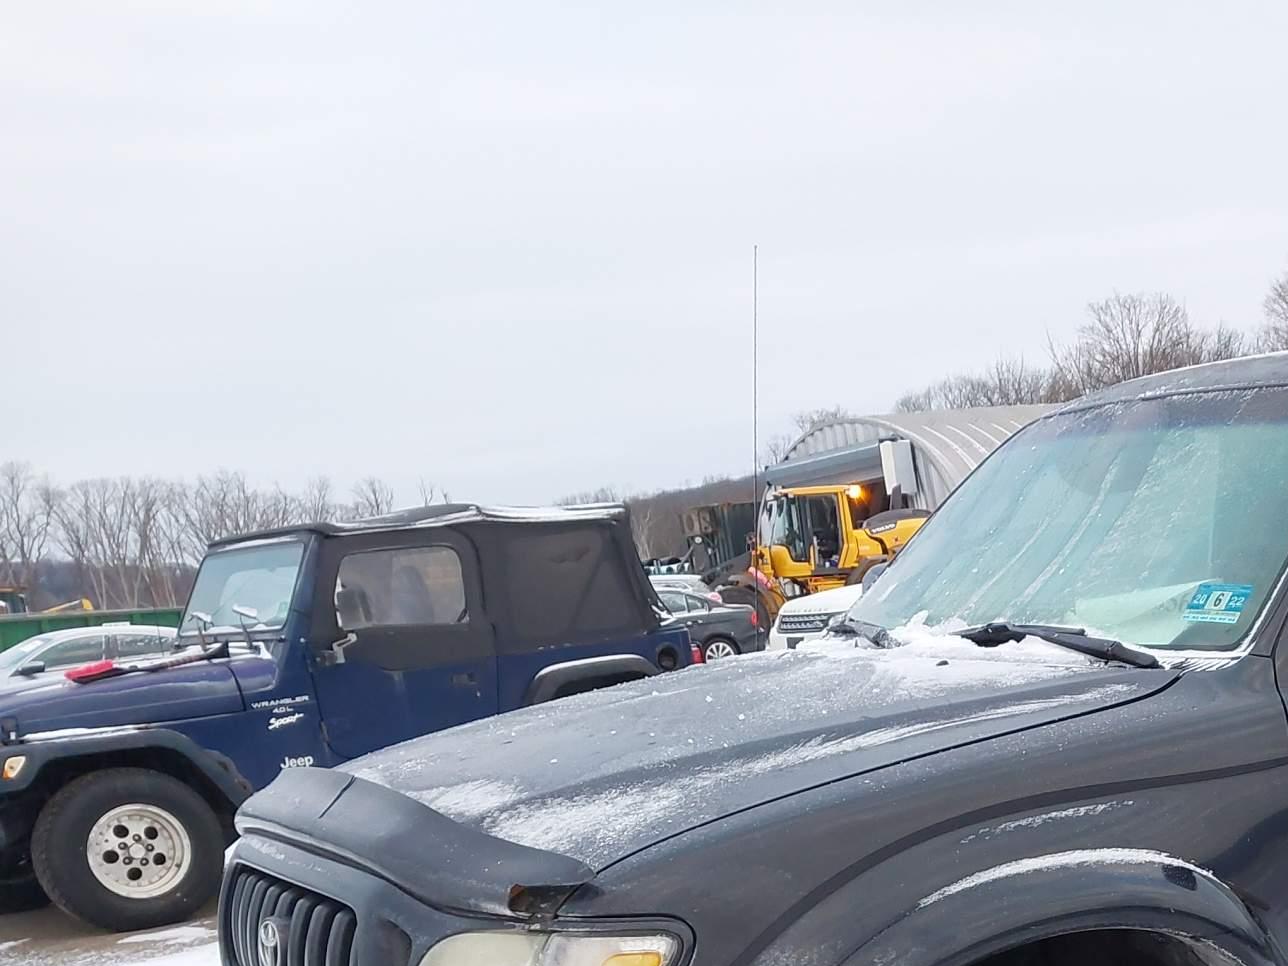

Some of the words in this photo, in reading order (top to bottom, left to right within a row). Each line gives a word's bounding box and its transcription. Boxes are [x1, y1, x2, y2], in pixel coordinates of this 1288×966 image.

[1193, 595, 1207, 604] 20
[1213, 593, 1224, 607] 6
[1228, 597, 1244, 606] 22
[251, 695, 310, 709] WRANGLER
[280, 755, 314, 769] Jeep
